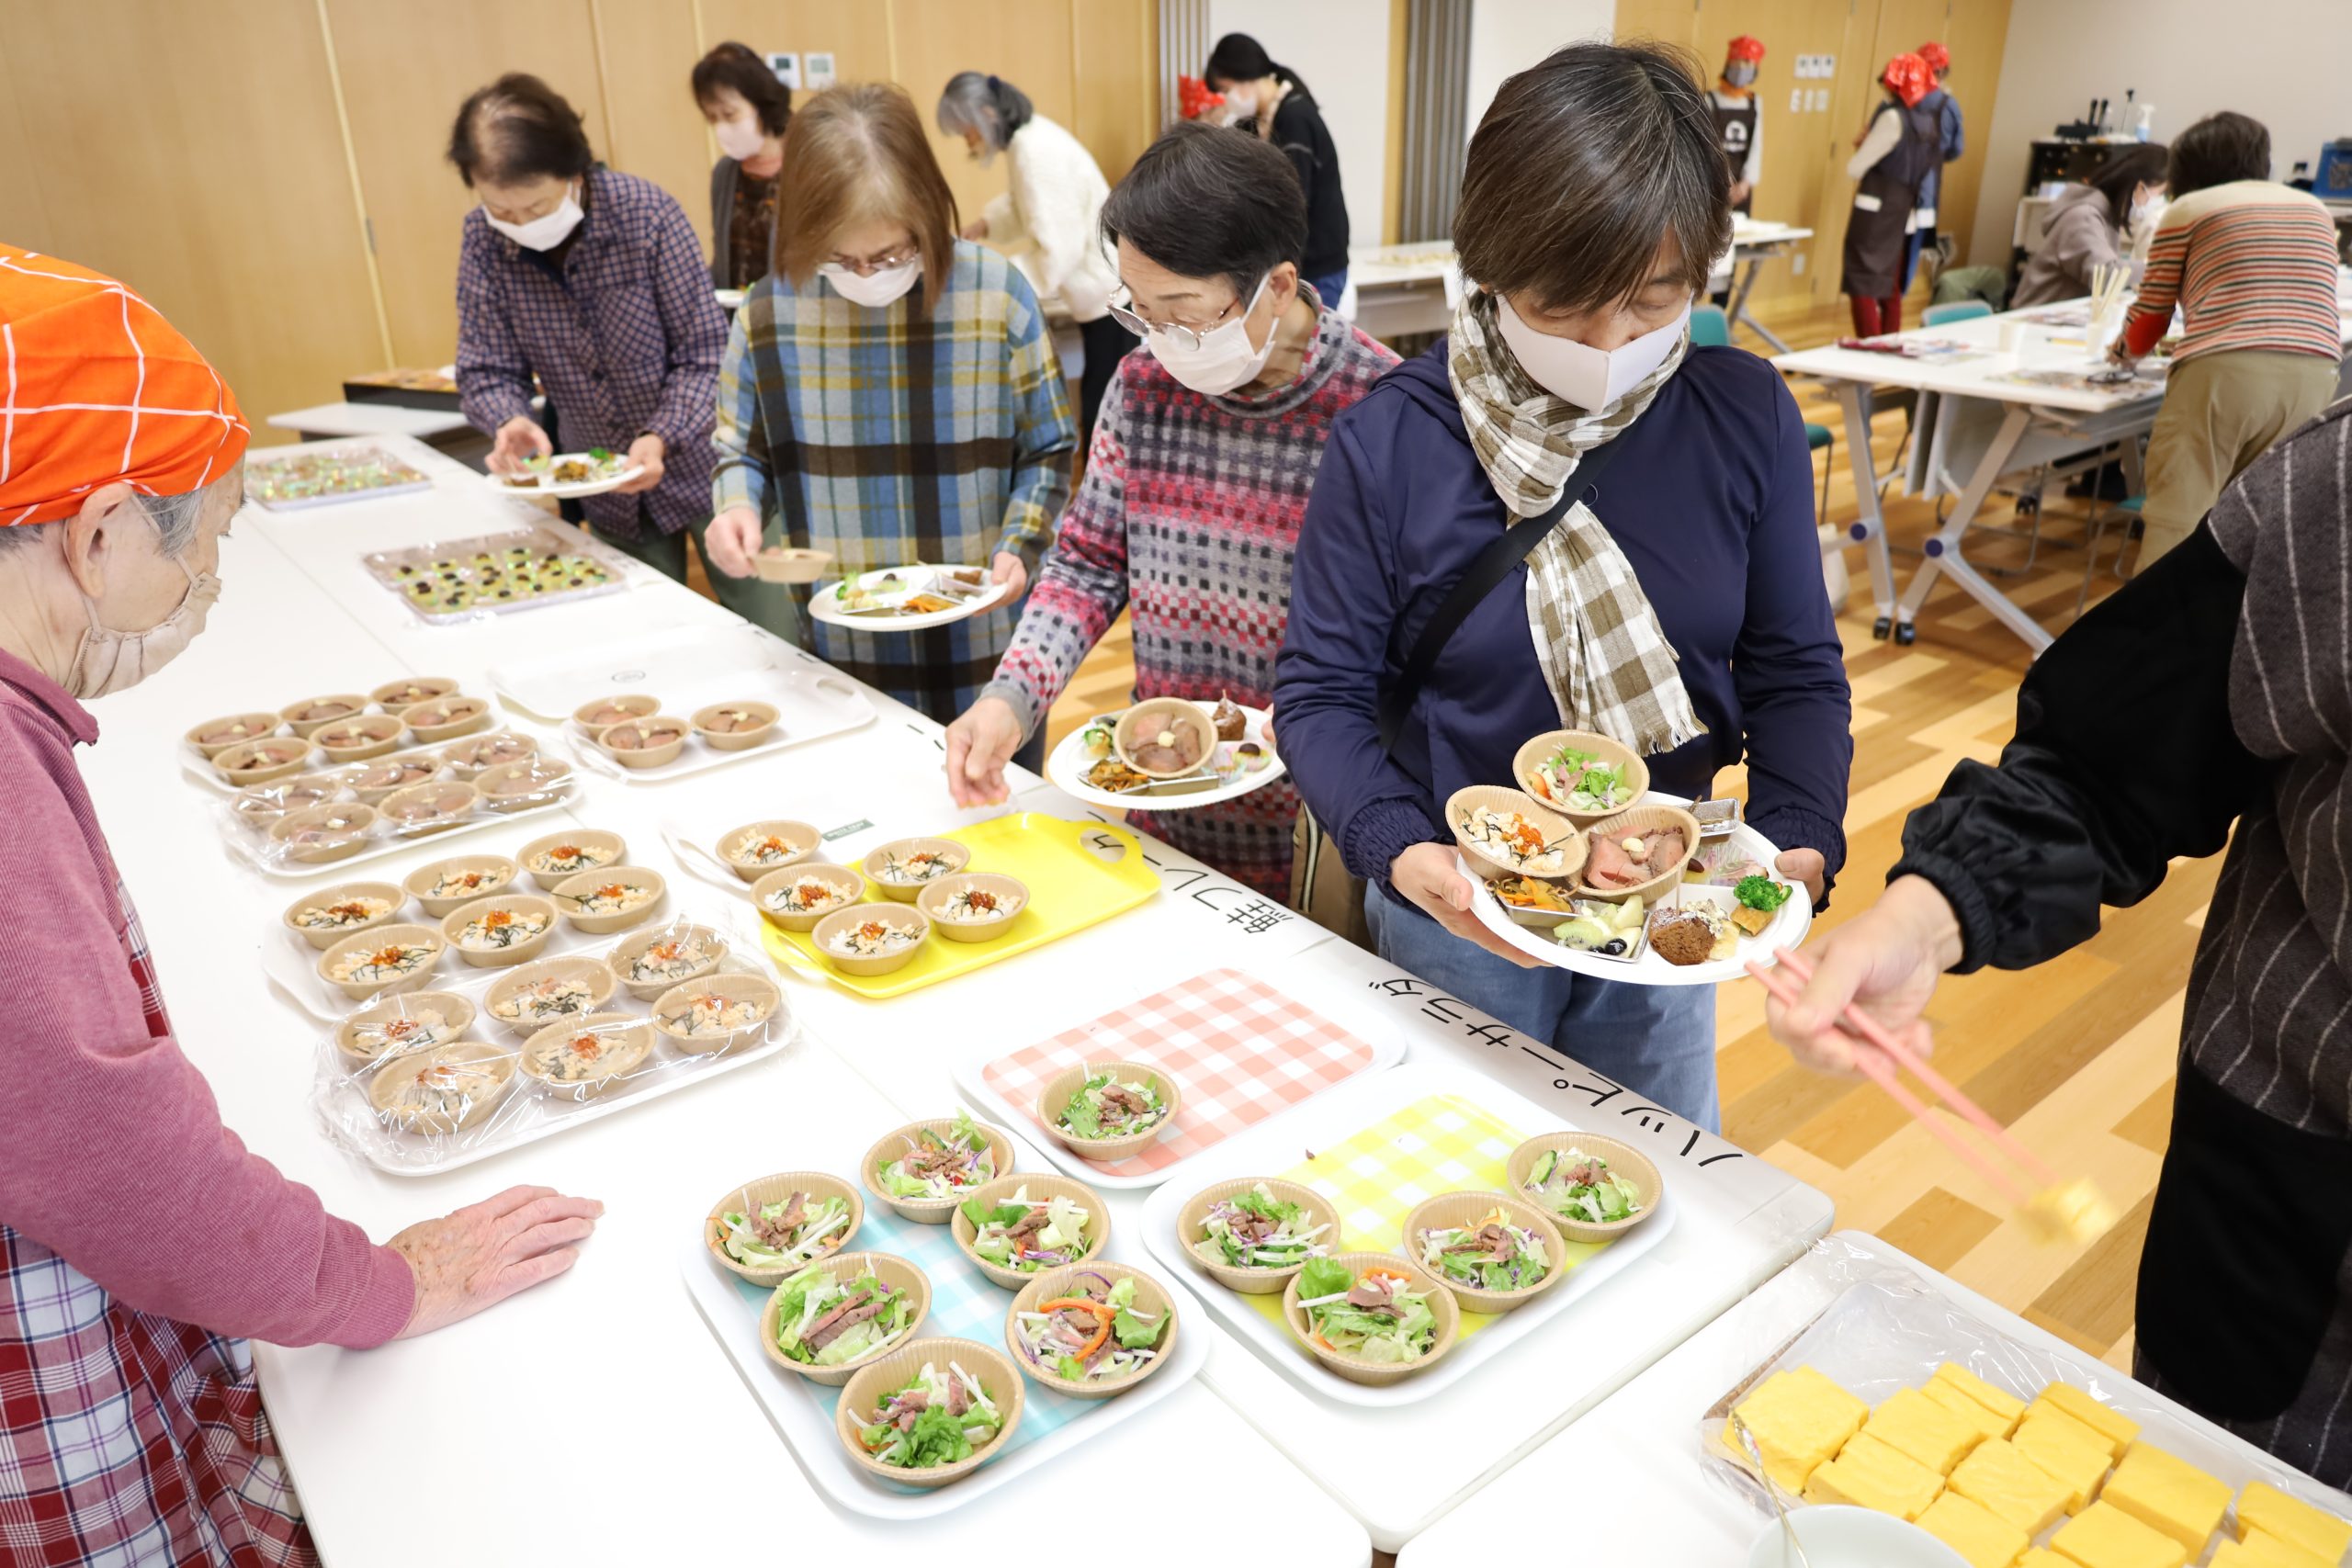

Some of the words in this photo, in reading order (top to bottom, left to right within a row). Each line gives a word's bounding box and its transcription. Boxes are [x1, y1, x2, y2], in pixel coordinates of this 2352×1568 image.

[1368, 978, 1743, 1168] ハッピーサラダ
